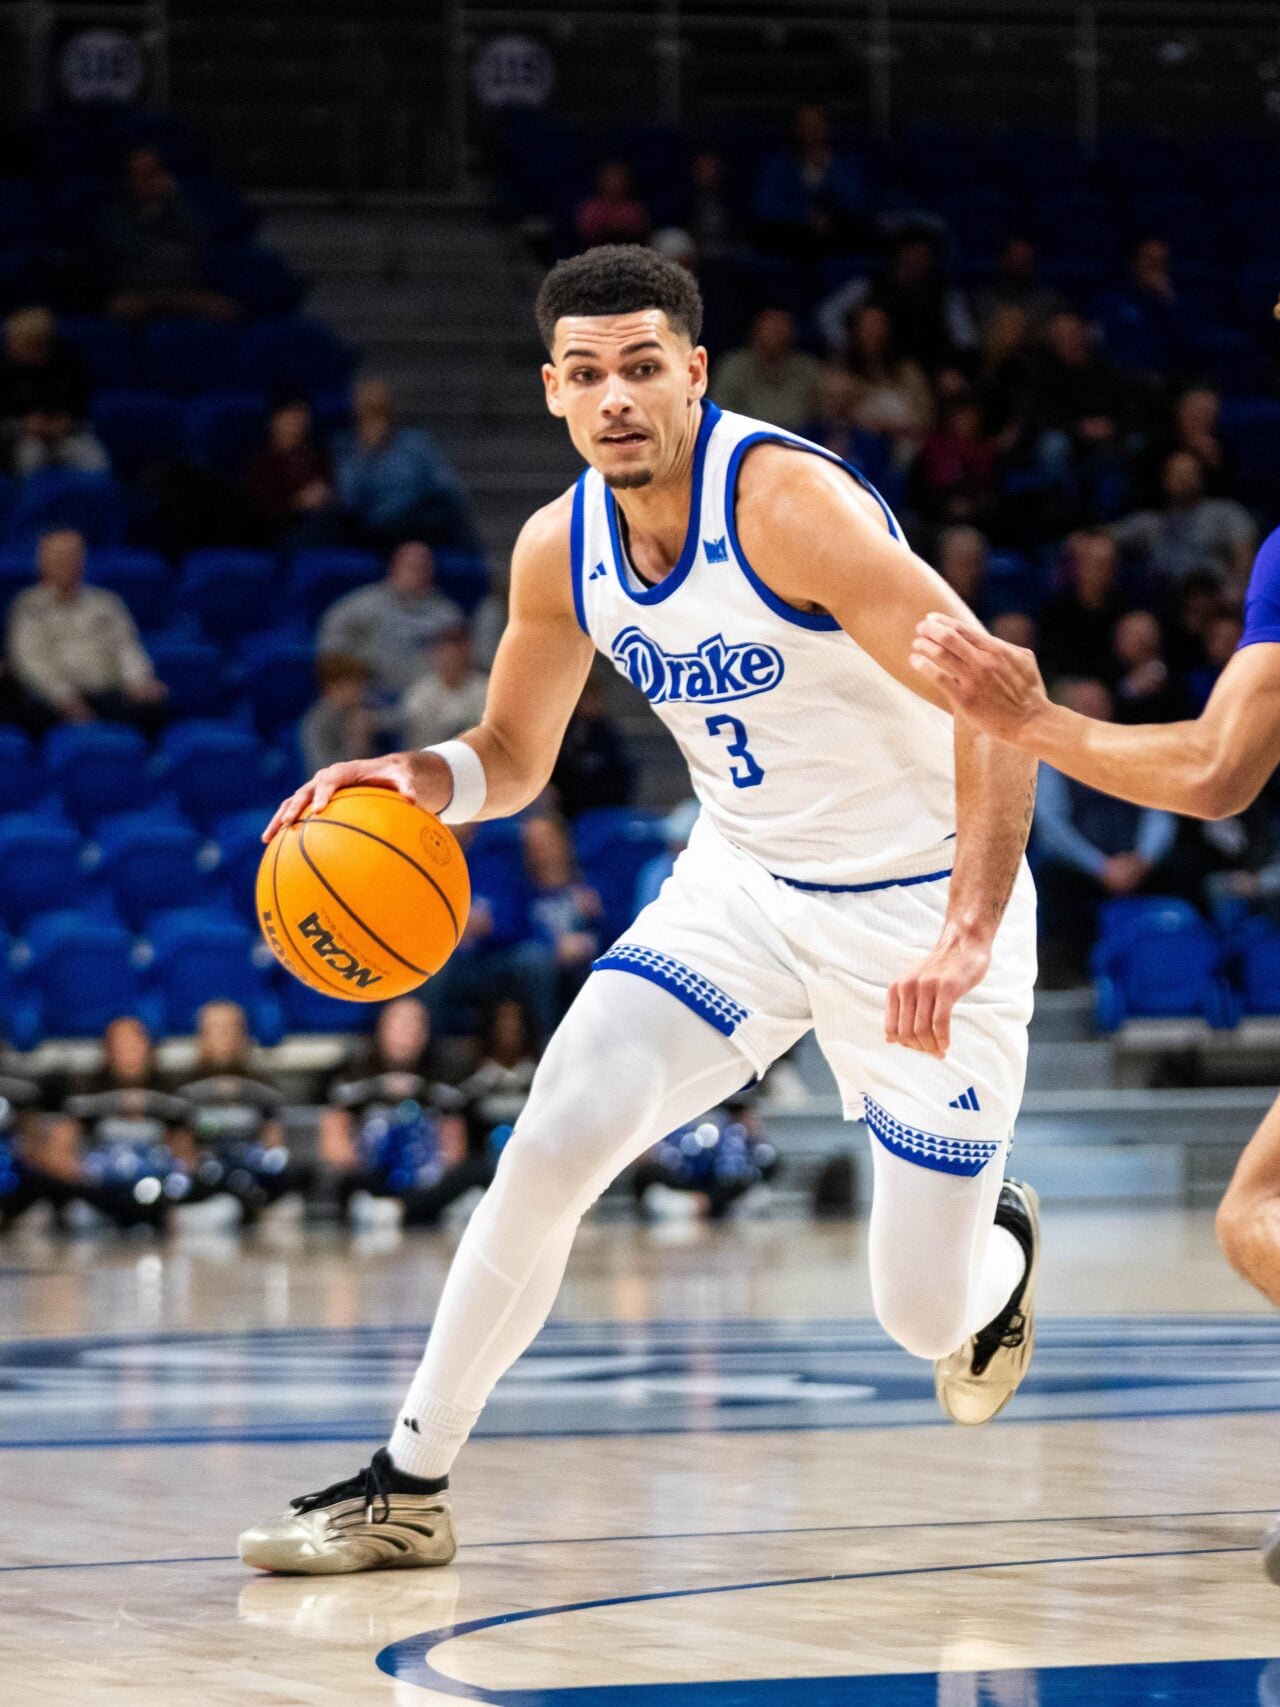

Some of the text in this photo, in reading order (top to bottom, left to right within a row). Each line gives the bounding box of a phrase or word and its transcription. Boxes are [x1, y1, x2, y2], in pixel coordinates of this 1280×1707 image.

[611, 625, 785, 705] Drake
[705, 713, 765, 789] 3
[297, 911, 383, 989] NCAA
